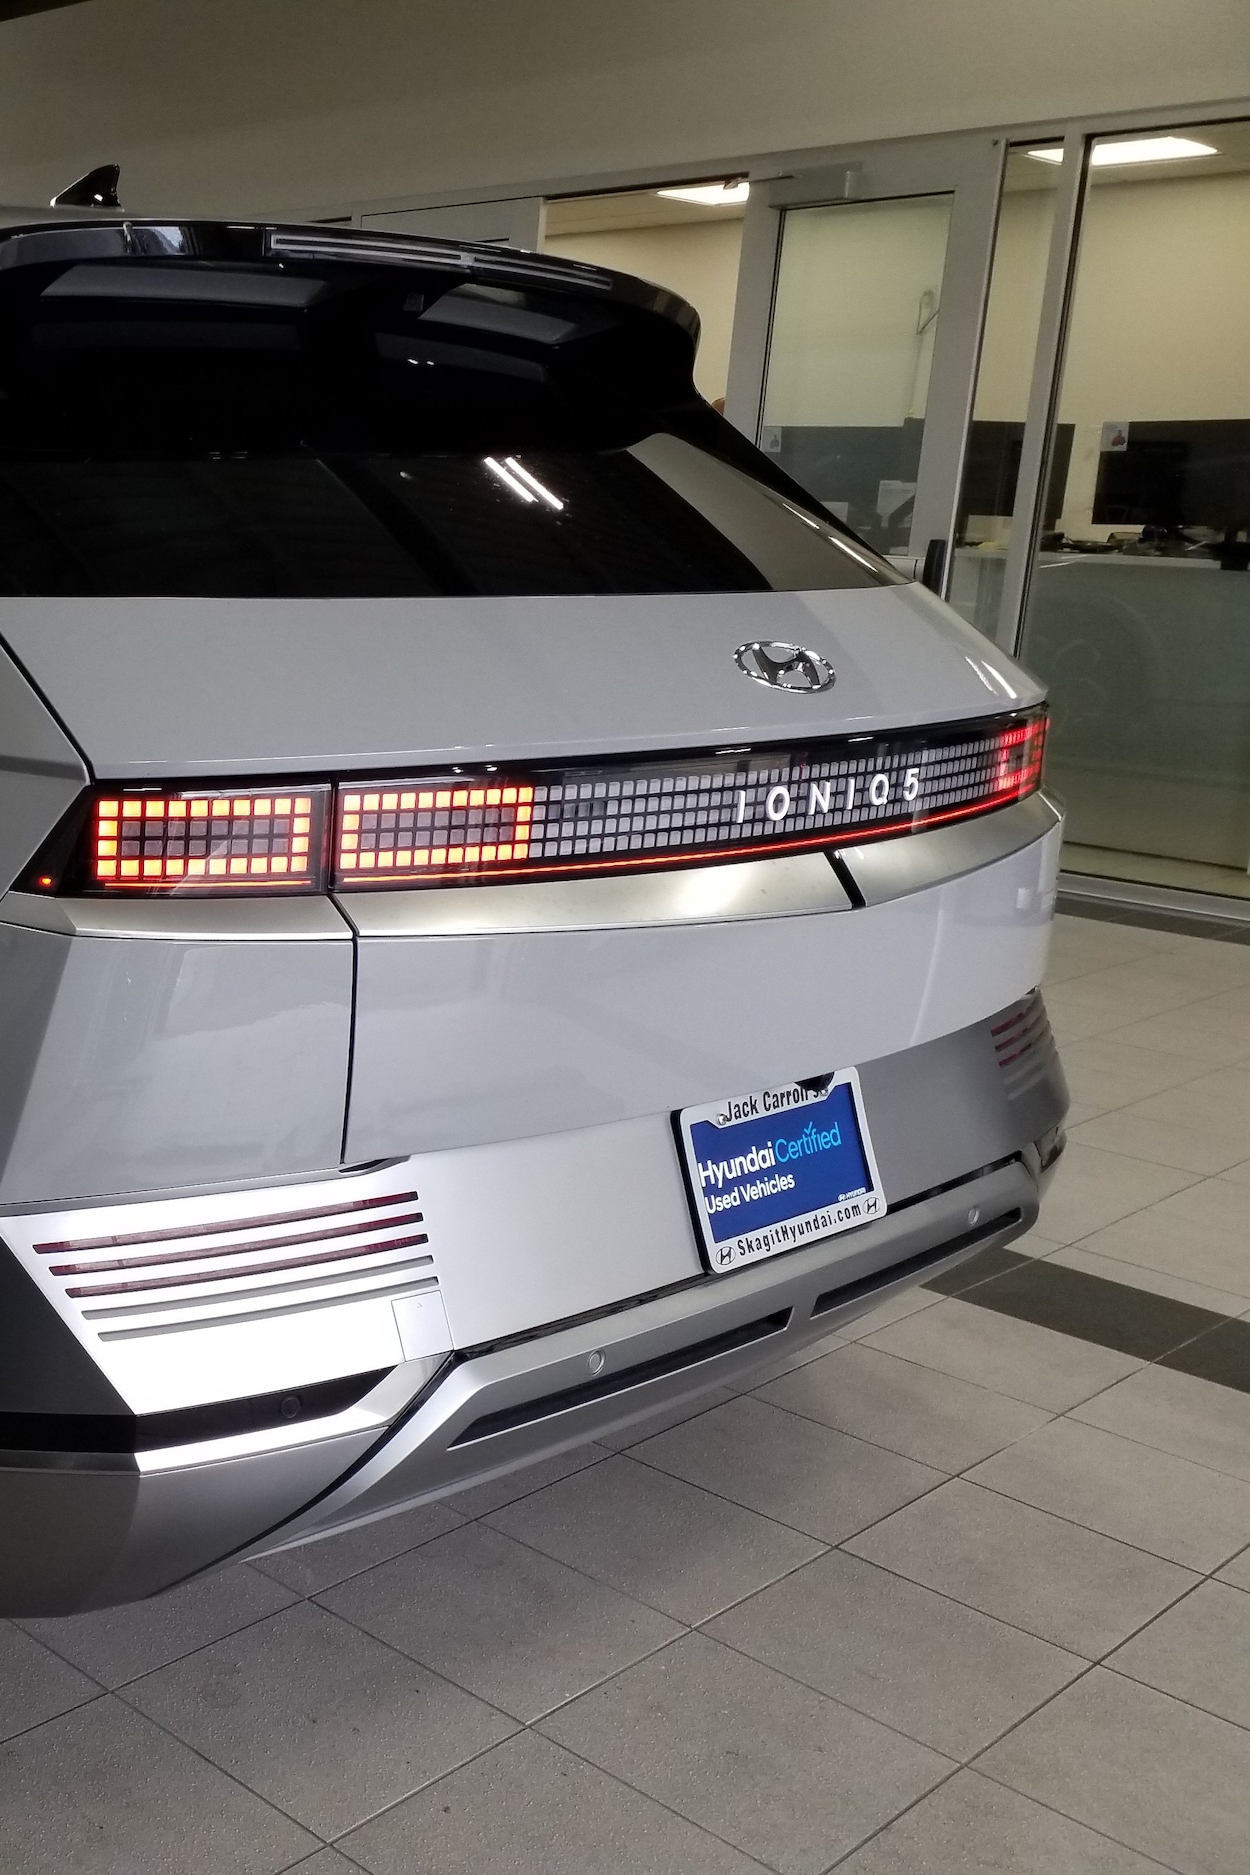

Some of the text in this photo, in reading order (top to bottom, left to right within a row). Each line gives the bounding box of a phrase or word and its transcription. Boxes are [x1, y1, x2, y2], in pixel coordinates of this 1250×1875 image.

[726, 1096, 759, 1122] Jack
[698, 1121, 842, 1188] Hyundai Certified
[704, 1174, 796, 1214] Used Vehicles
[737, 1204, 862, 1256] SkagitHyundai.com
